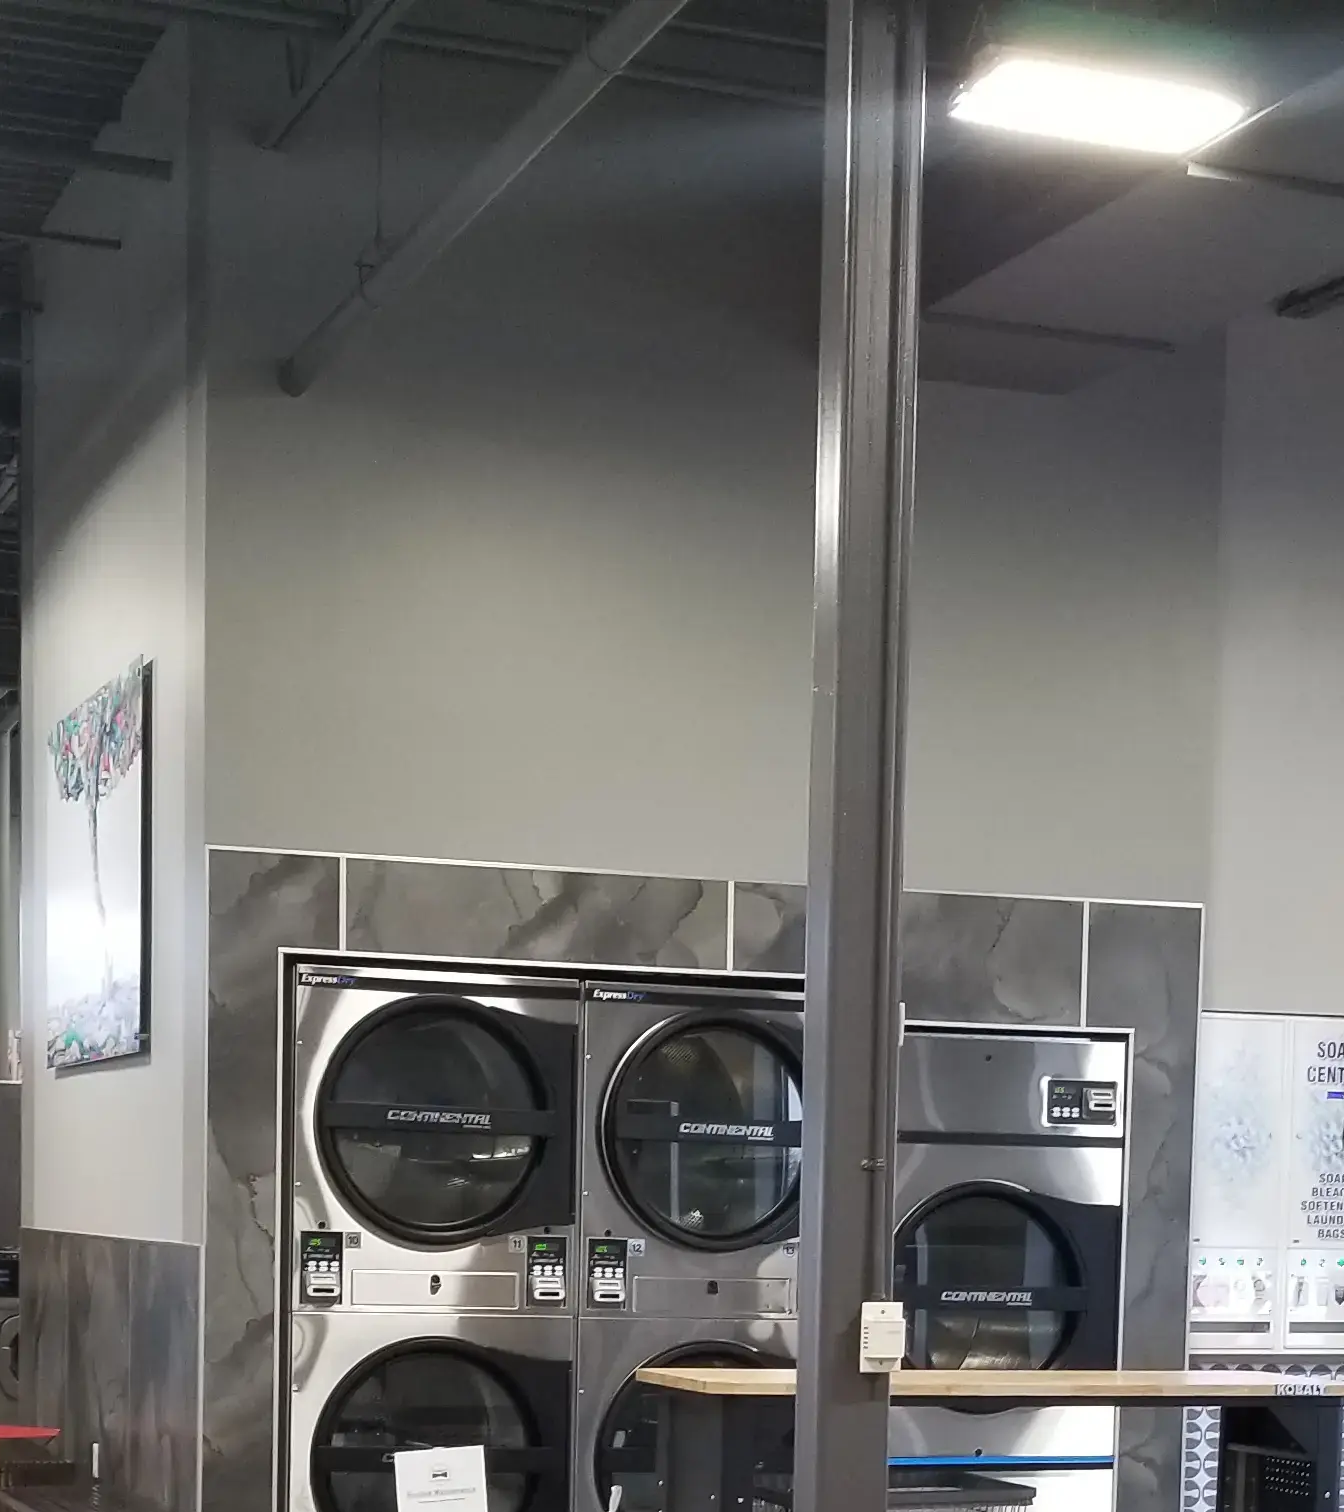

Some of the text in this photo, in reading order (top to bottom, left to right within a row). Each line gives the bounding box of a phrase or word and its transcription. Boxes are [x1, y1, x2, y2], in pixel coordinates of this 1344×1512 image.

[679, 1122, 774, 1136] CONTINENTAL
[941, 1291, 1032, 1302] CONTINENTAL
[1275, 1384, 1325, 1397] KOBALT
